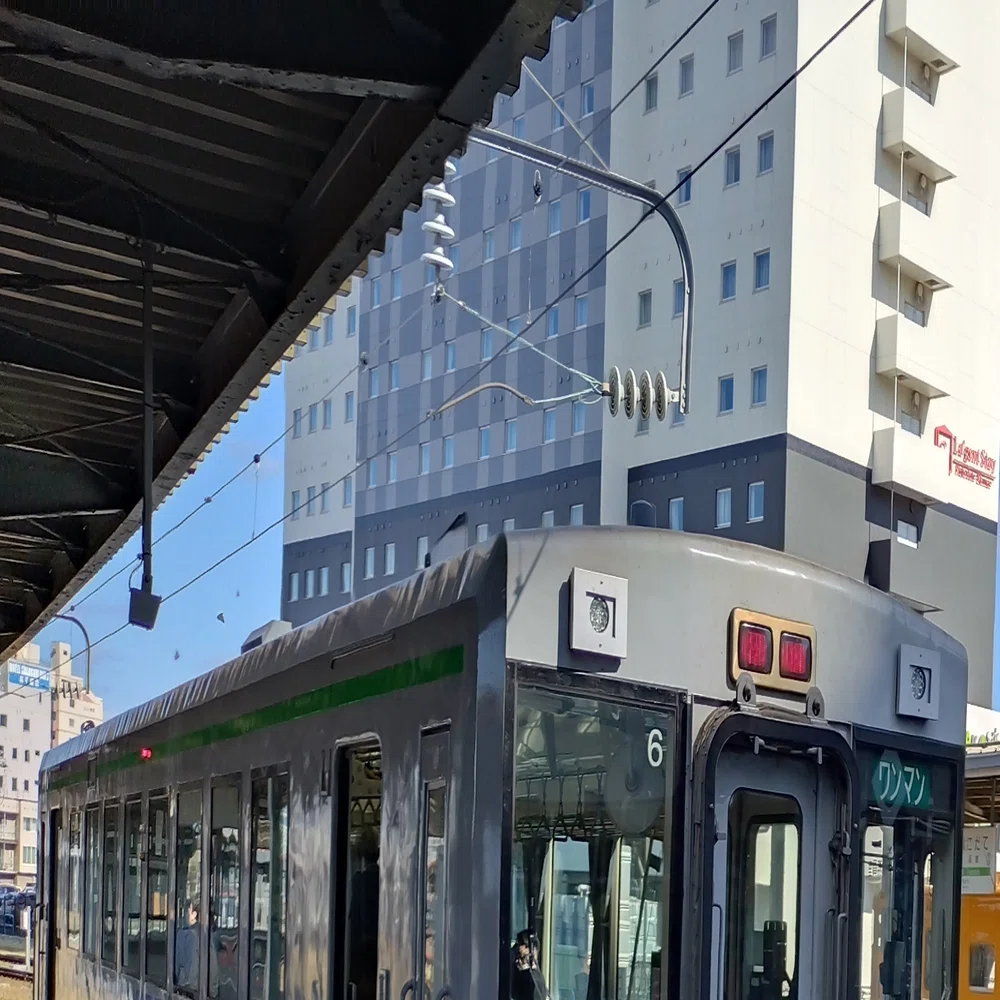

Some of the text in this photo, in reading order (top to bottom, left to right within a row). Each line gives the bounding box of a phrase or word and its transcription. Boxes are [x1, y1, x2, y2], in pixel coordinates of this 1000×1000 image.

[980, 449, 997, 475] Stay
[647, 728, 664, 768] 6
[879, 760, 926, 806] ワンマン
